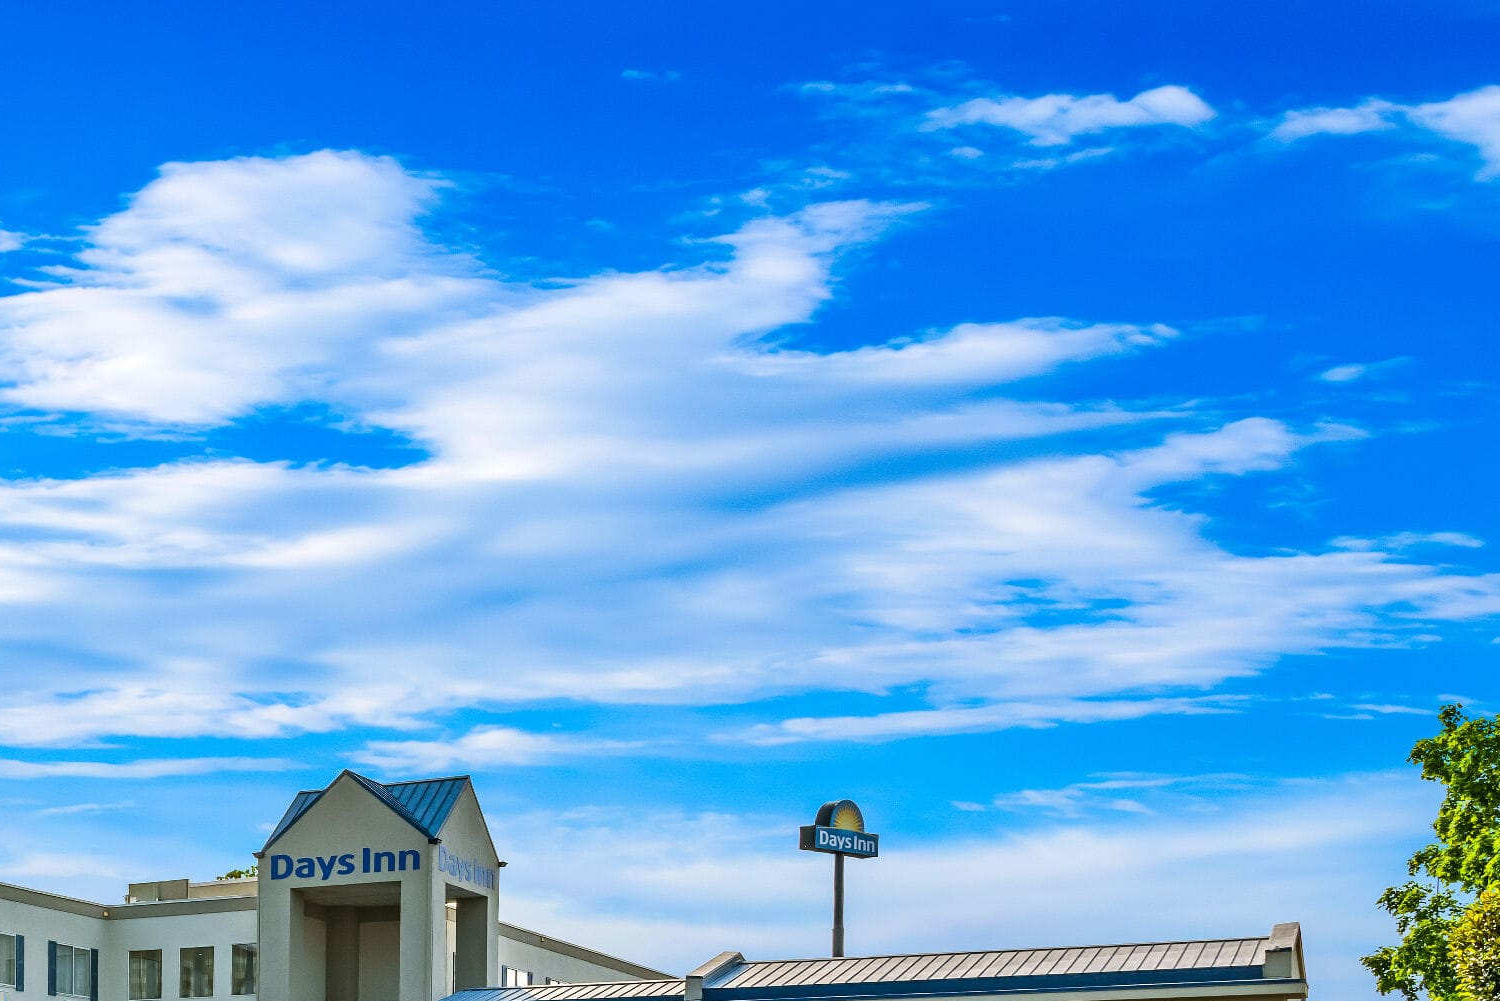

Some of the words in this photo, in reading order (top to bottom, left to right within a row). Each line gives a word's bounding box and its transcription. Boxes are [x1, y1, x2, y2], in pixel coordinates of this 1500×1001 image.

[819, 830, 851, 849] Days
[853, 836, 875, 852] Inn
[270, 853, 355, 880] Days
[362, 847, 420, 873] Inn
[438, 845, 472, 882] Days
[473, 858, 495, 889] Inn
